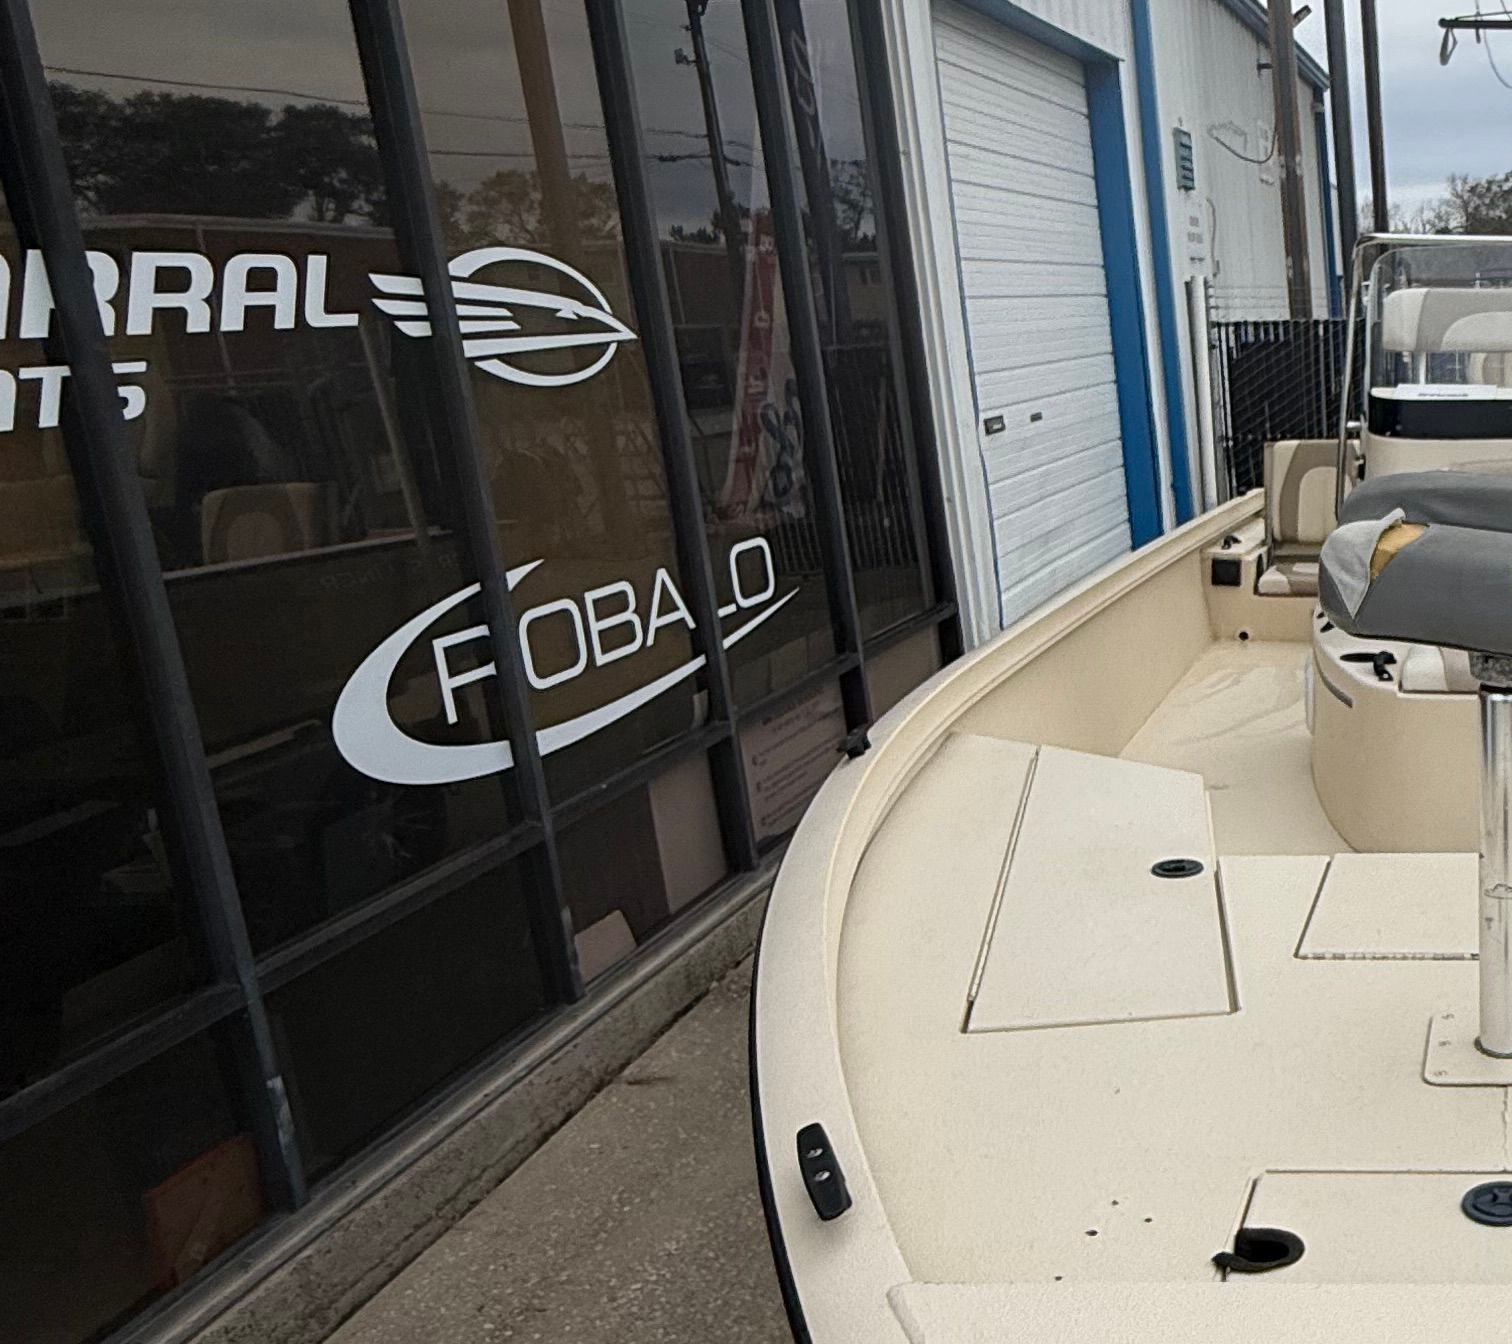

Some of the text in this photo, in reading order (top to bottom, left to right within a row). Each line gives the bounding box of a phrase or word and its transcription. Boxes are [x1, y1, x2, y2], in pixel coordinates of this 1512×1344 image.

[0, 248, 359, 339] RRAL
[0, 360, 148, 432] TS
[432, 536, 776, 725] ROBAO
